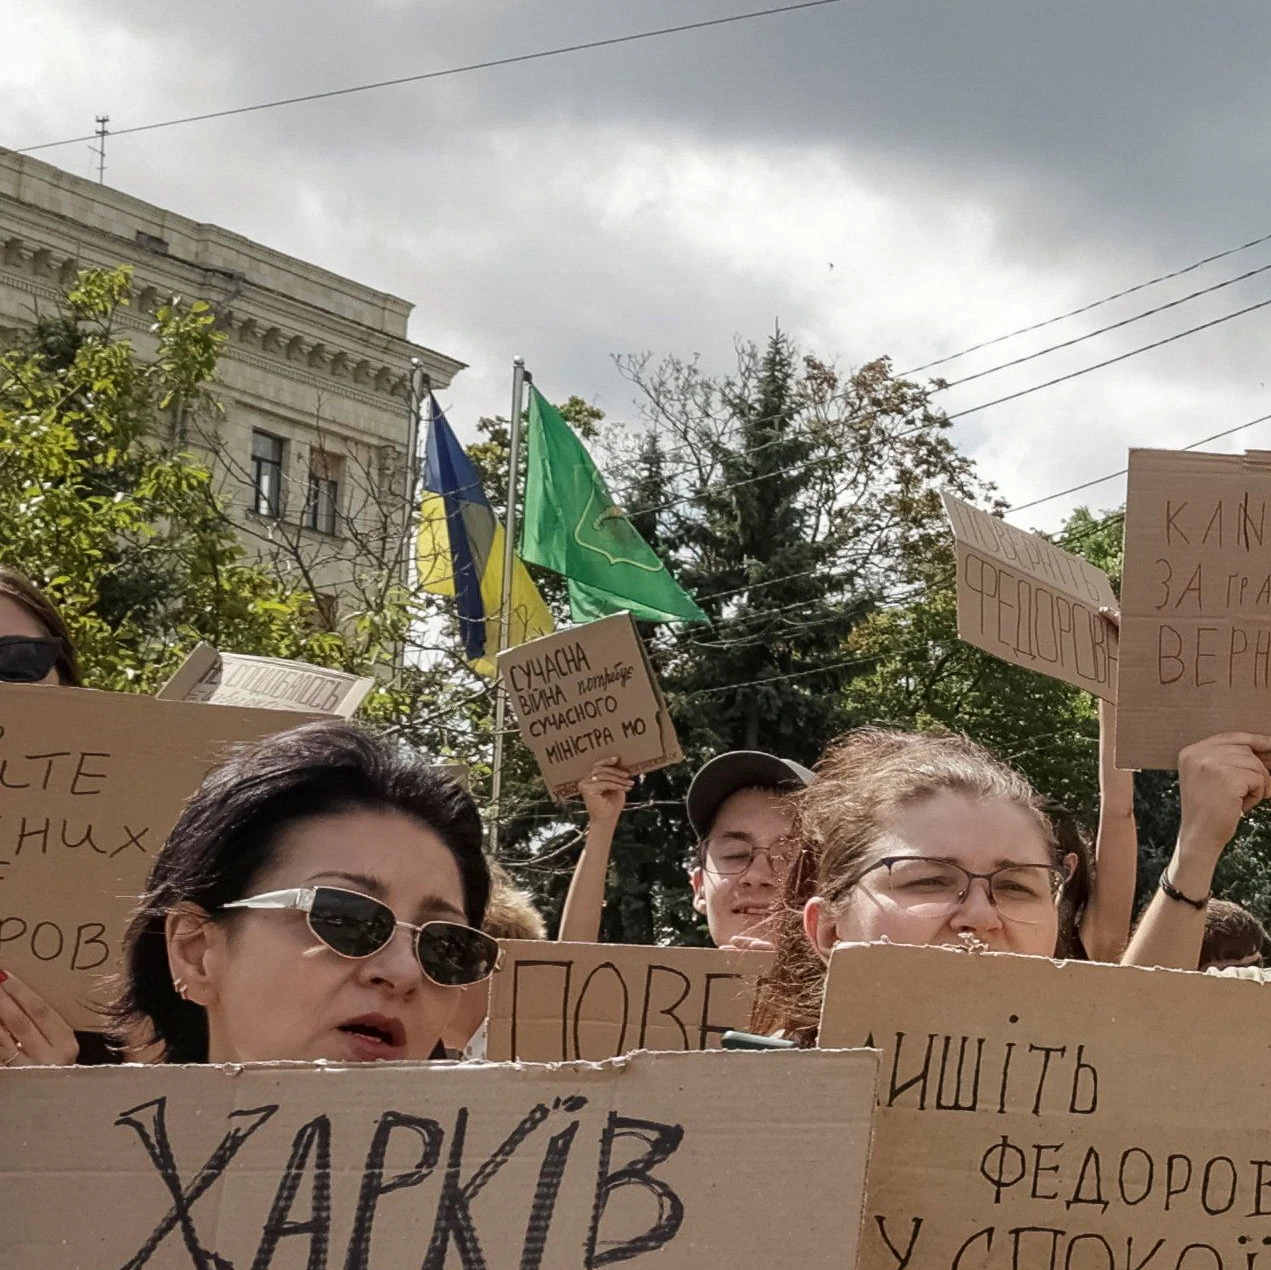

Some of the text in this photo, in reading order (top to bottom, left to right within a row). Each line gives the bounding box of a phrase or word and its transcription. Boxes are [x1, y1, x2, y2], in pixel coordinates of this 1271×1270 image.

[1154, 557, 1203, 612] ЗА
[509, 642, 591, 693] СУЧАСНА
[529, 695, 618, 738] СУЧАСНОГО
[621, 717, 646, 739] МО
[864, 1014, 1099, 1116] ИШІТЬ
